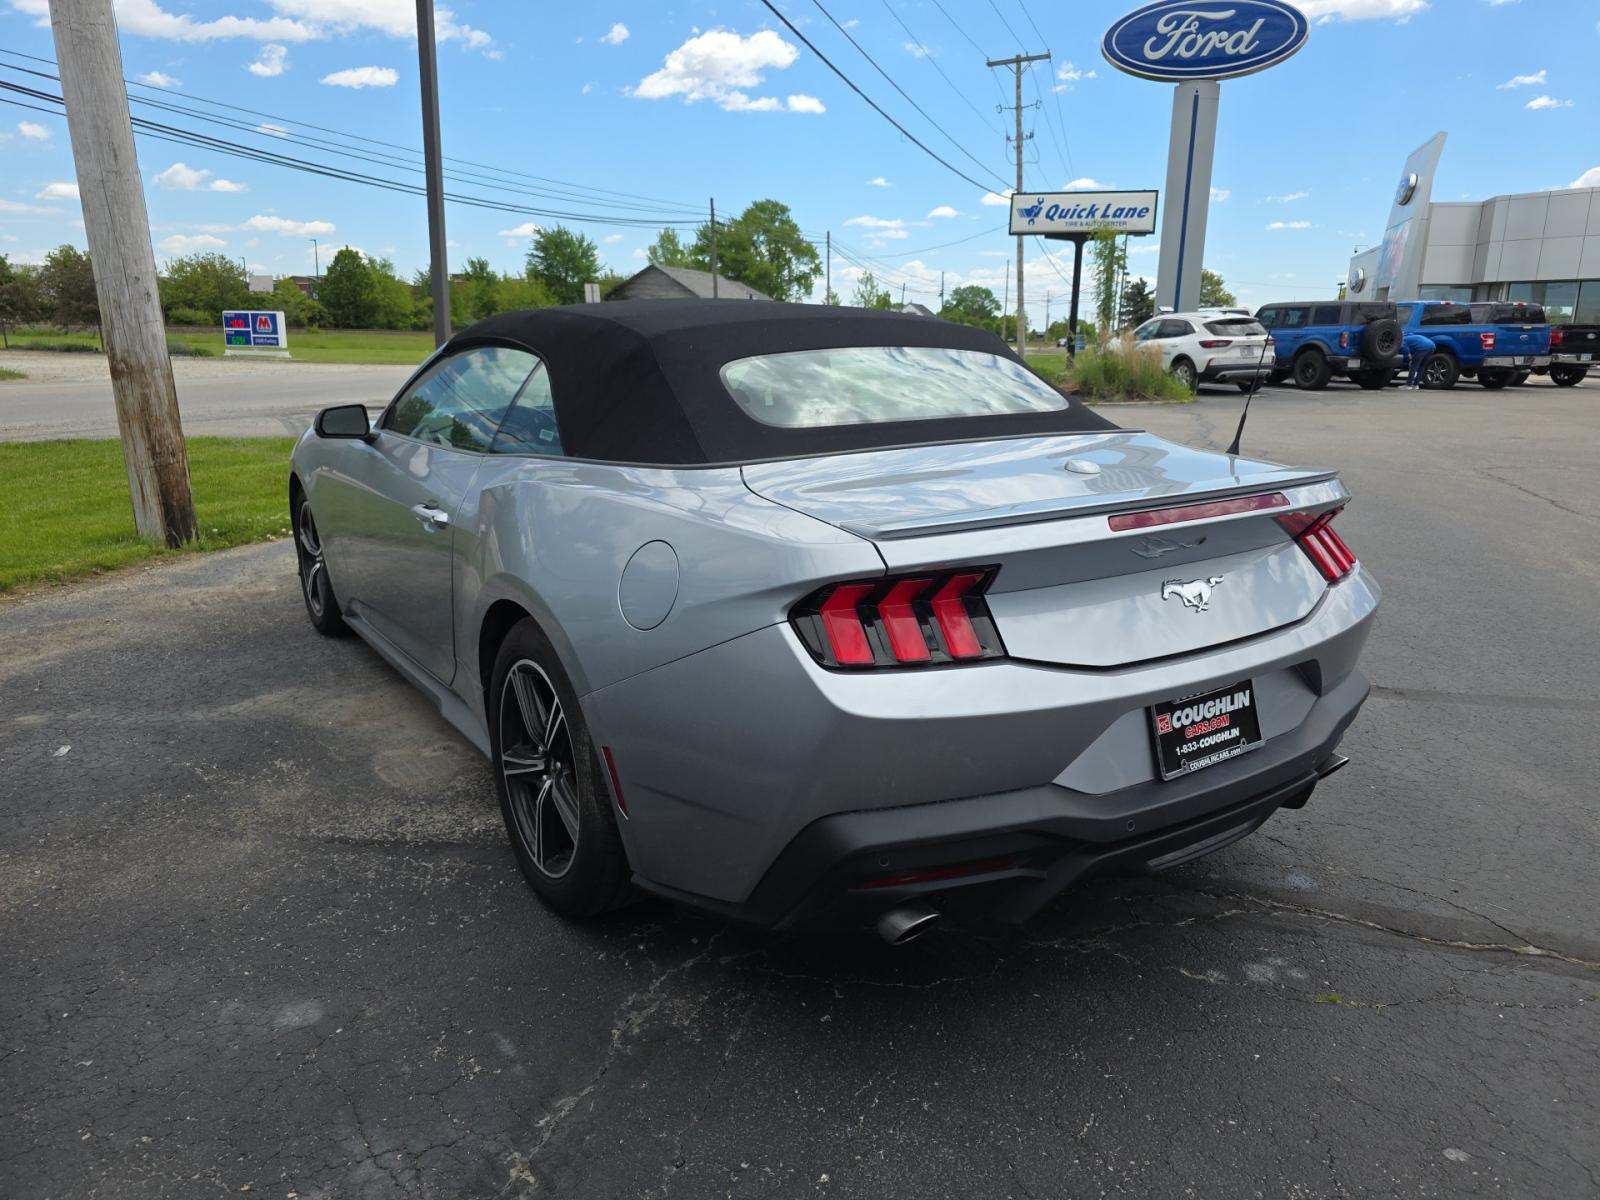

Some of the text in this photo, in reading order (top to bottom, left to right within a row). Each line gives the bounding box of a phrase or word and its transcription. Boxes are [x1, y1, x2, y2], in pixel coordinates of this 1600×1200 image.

[1143, 9, 1265, 60] Ford
[1045, 203, 1150, 221] Quick Lane
[1172, 689, 1250, 728] COUGHLIN
[1185, 714, 1230, 738] CARS.COM
